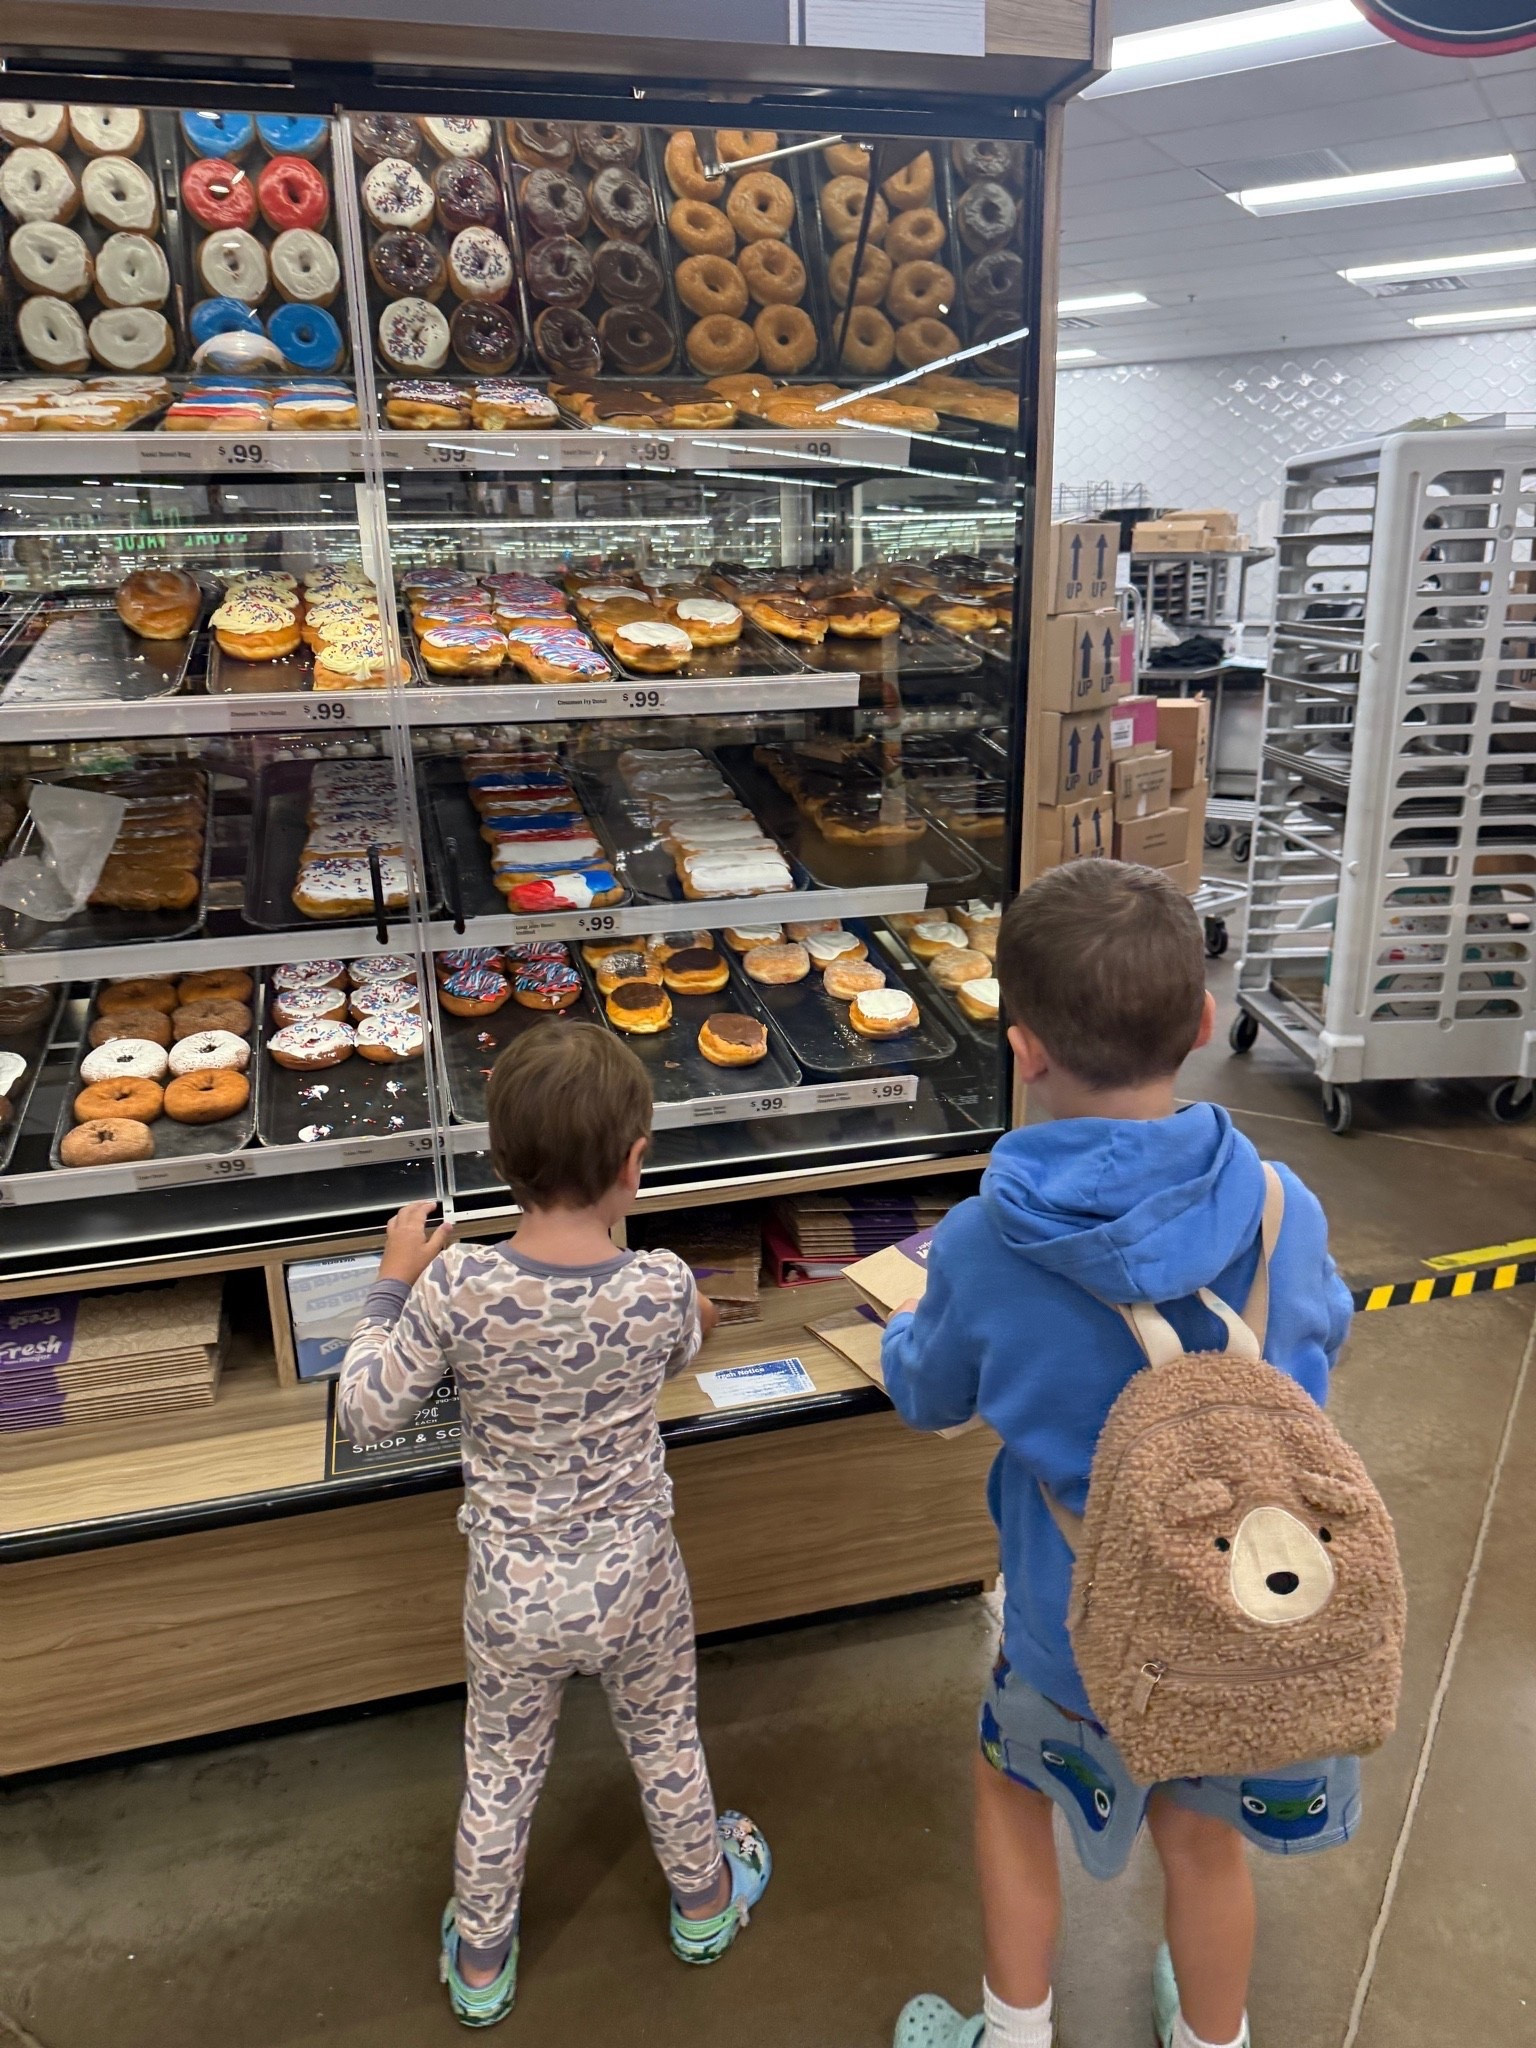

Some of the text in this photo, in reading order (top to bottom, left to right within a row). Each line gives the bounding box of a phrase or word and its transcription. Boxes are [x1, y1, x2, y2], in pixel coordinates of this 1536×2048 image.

[1066, 581, 1107, 599] UP UP
[1077, 676, 1115, 697] UP UP
[1065, 770, 1103, 791] UP UP
[415, 1419, 438, 1427] EACH
[352, 1437, 406, 1454] SHOP
[415, 1433, 427, 1444] &
[436, 1428, 462, 1440] SC
